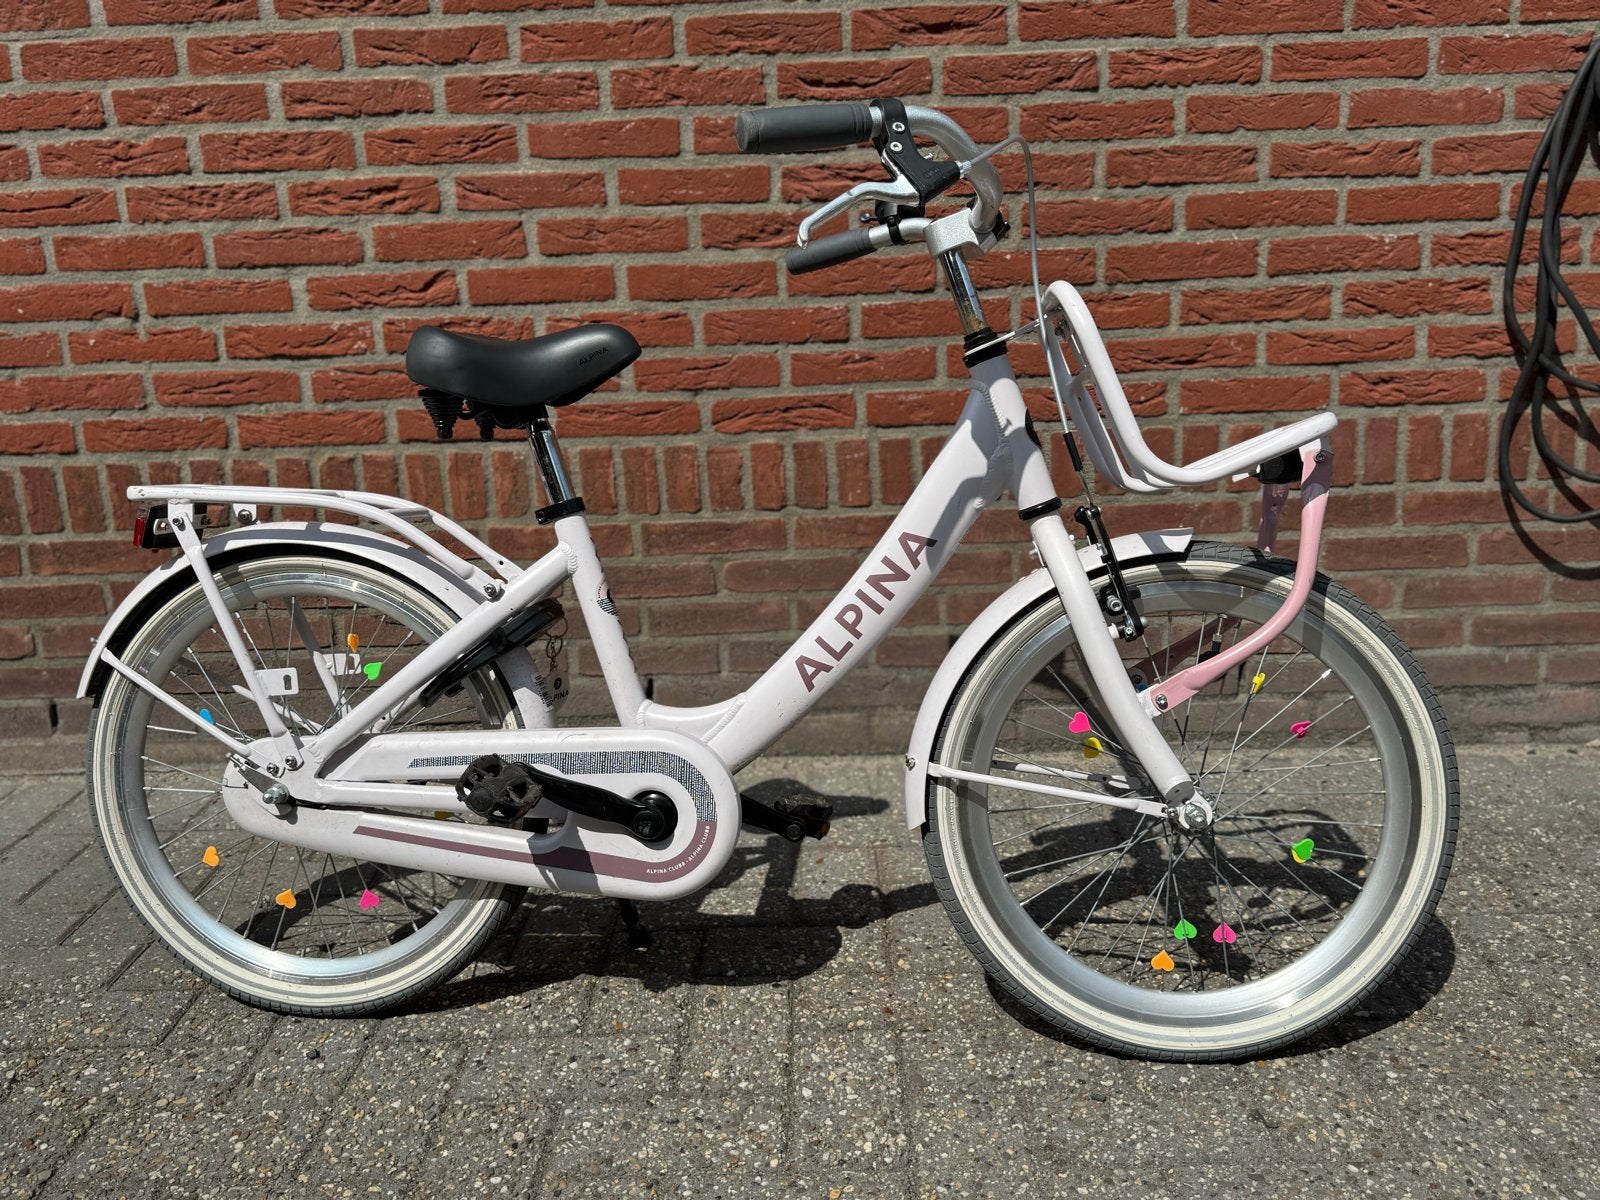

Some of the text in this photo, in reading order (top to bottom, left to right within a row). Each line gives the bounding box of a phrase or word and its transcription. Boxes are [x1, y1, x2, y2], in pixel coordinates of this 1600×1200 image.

[579, 346, 609, 366] ALPINA
[795, 531, 938, 693] ALPINA
[668, 861, 686, 872] CLUBB
[688, 844, 703, 862] ALPINA
[702, 825, 711, 844] CLUBB
